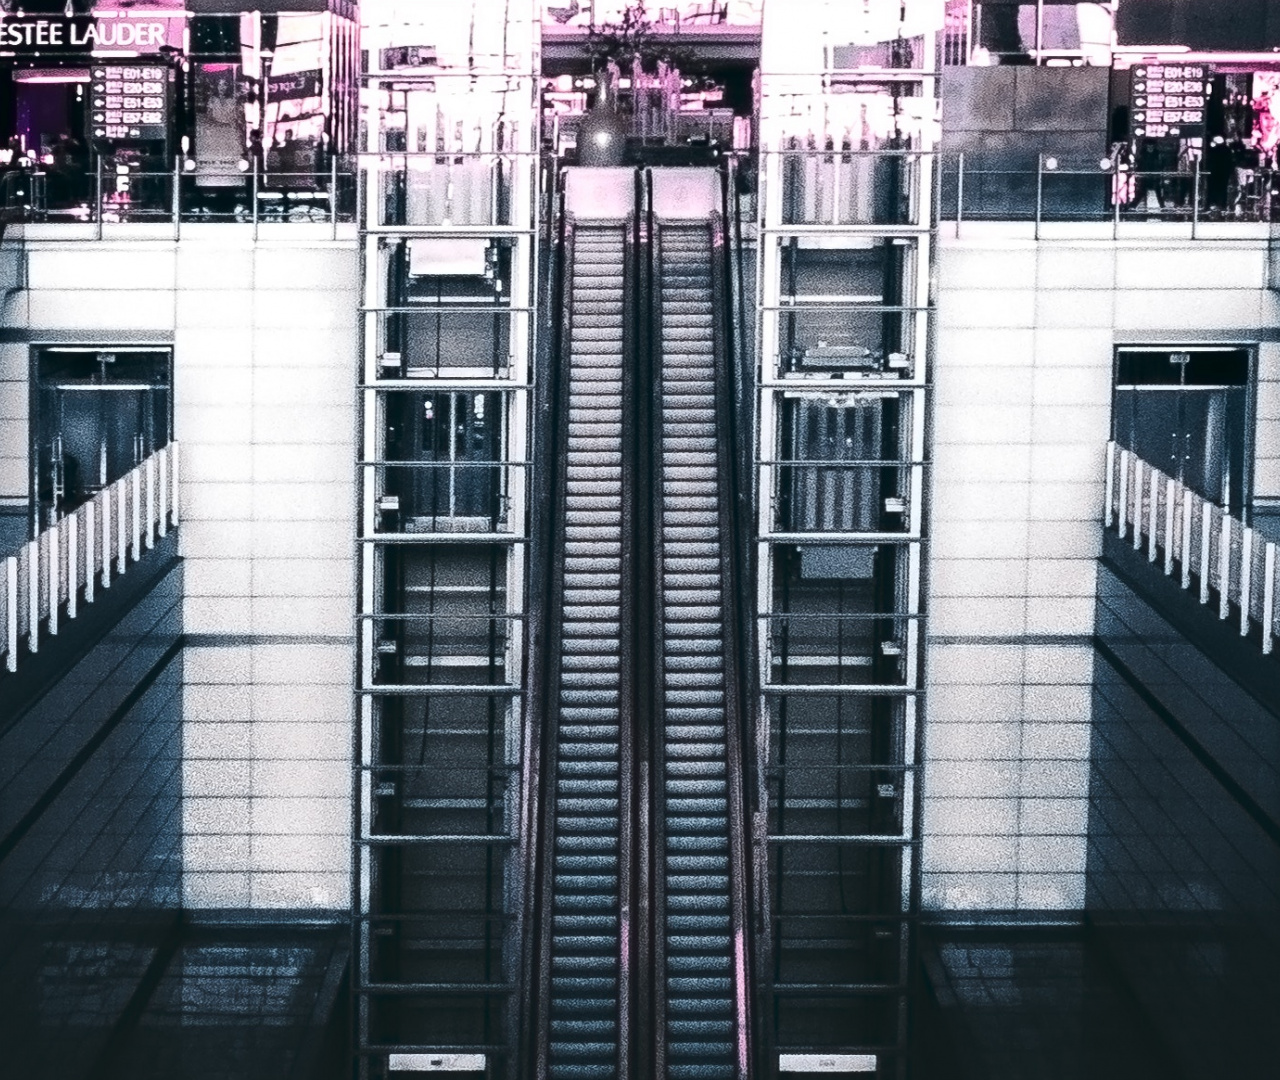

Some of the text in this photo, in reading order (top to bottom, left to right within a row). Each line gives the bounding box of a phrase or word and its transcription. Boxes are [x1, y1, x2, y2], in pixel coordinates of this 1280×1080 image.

[70, 23, 166, 46] LAUDER
[123, 67, 162, 80] E01-E19
[1164, 66, 1203, 79] E01-E19
